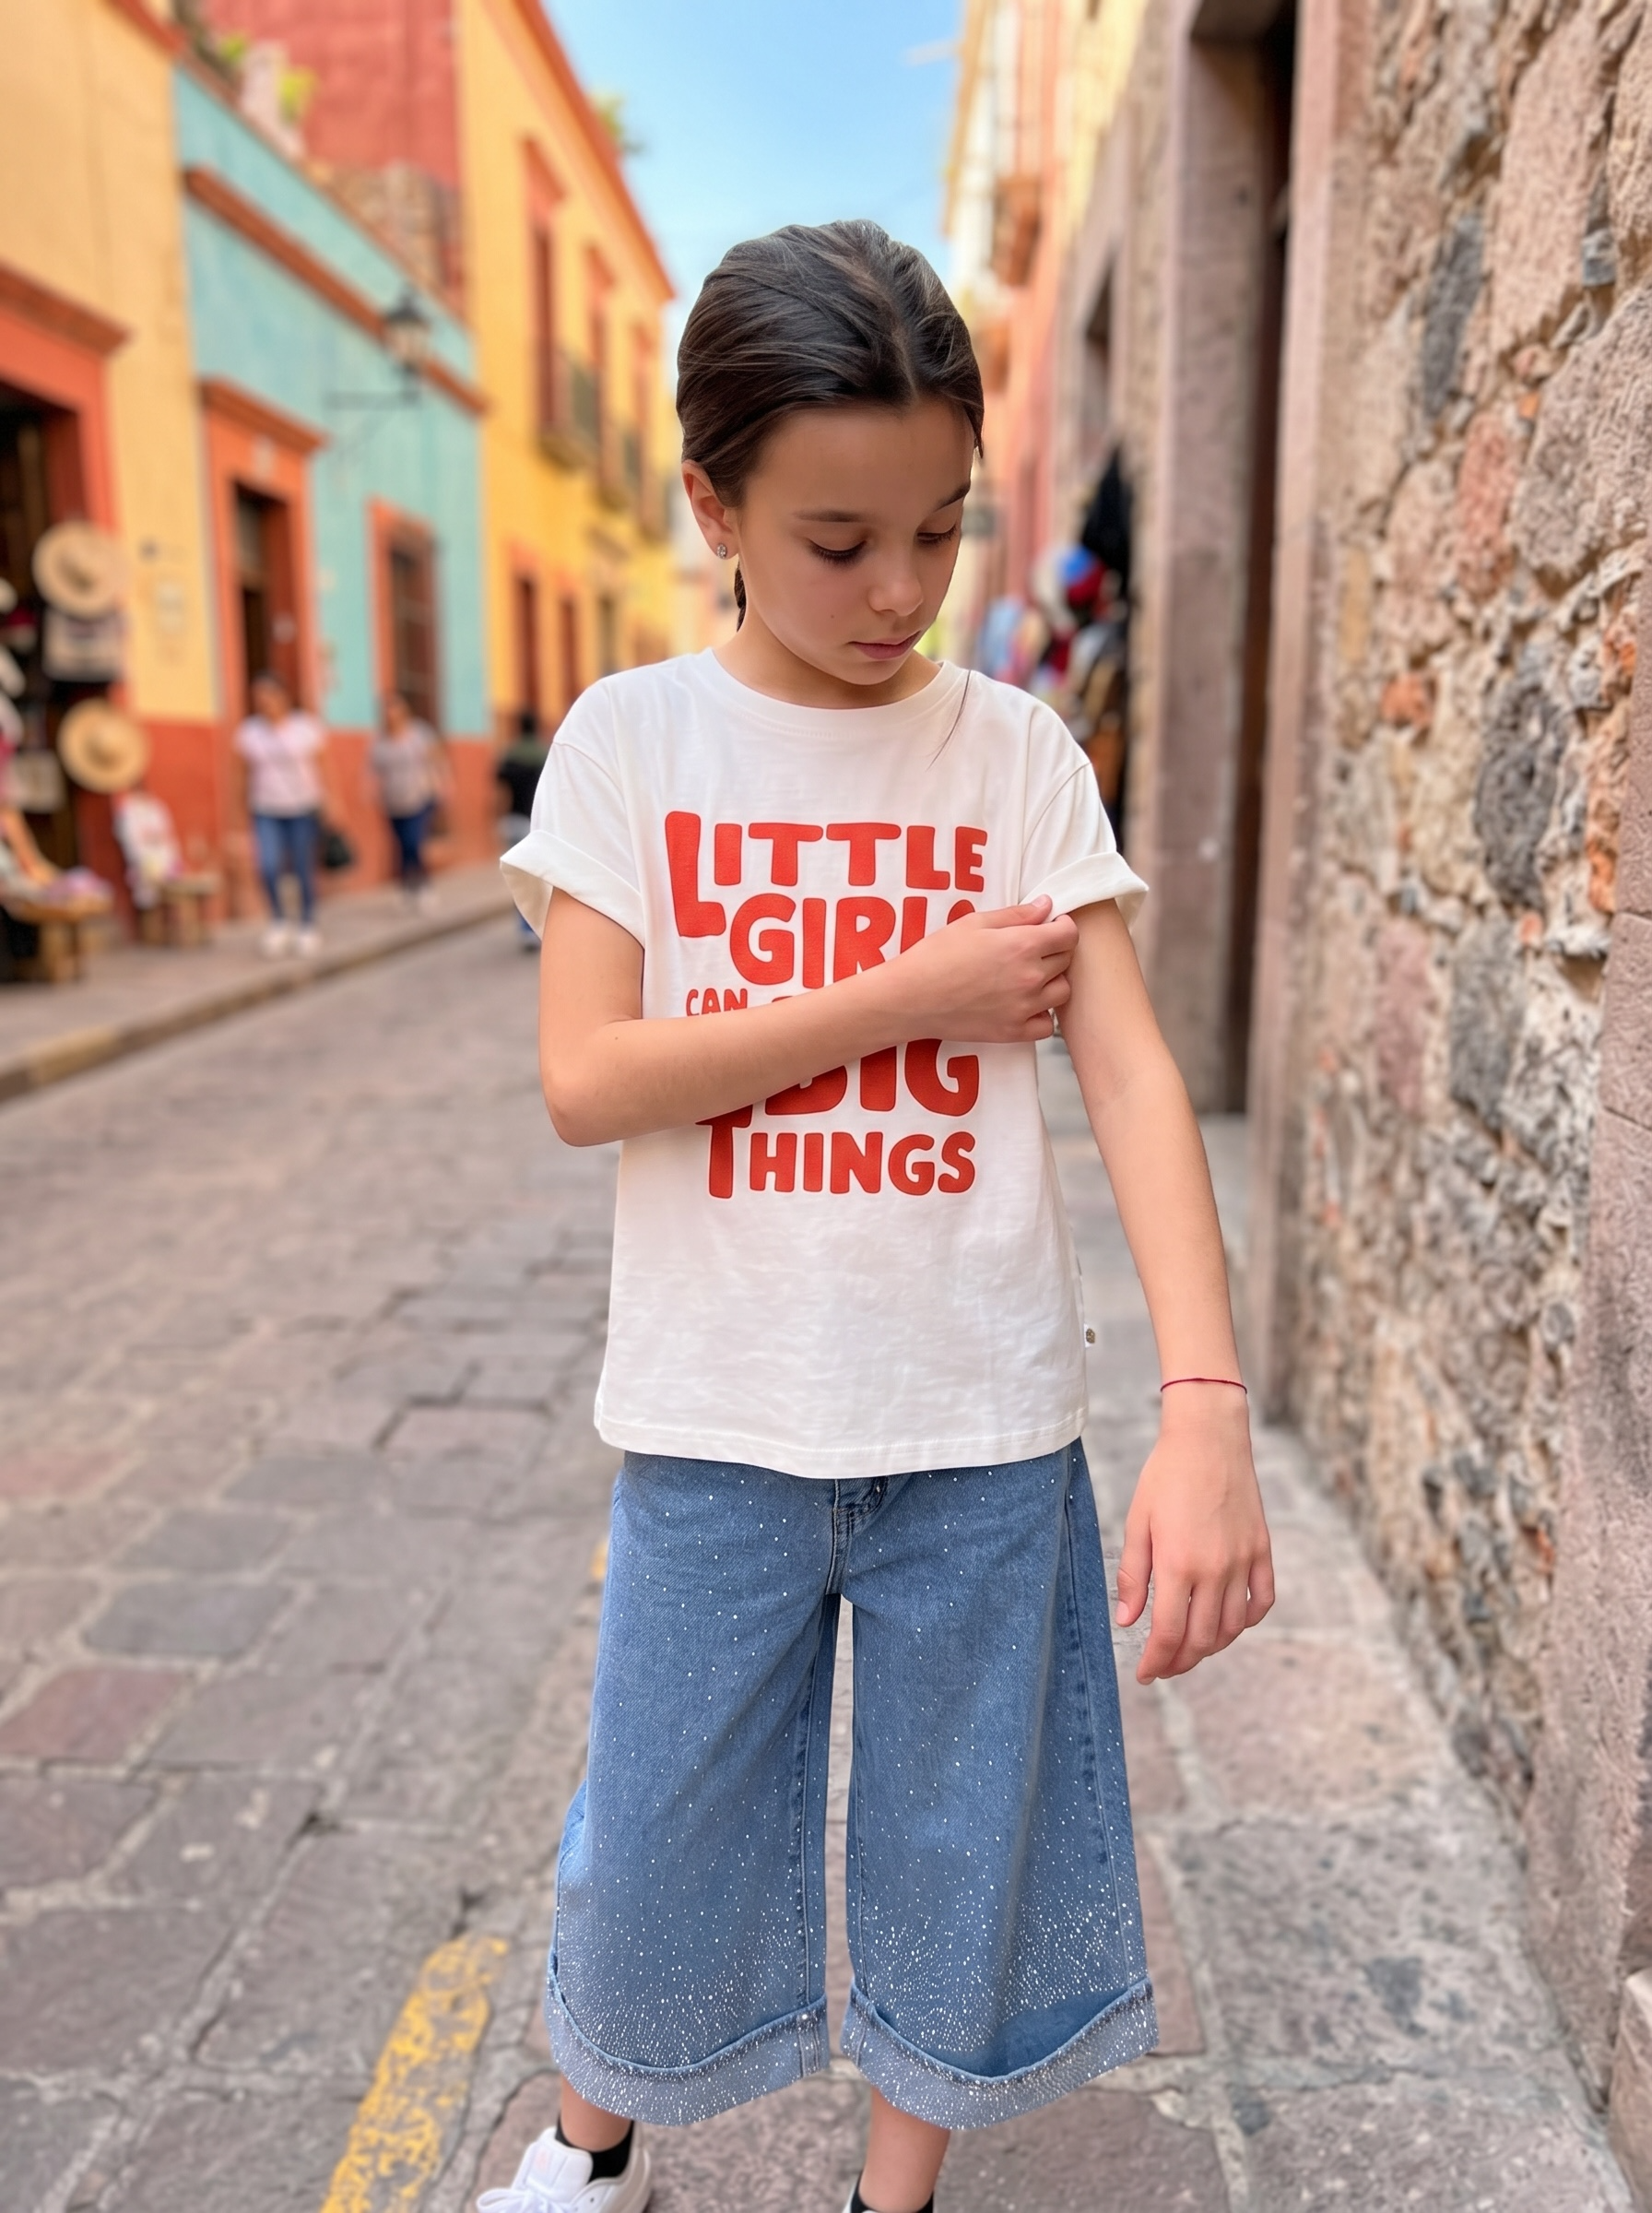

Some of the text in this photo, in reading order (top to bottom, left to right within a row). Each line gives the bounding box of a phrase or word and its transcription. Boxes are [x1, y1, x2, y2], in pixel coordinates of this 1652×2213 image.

[665, 811, 987, 939] LITTLE
[729, 893, 975, 989] GIR
[686, 988, 748, 1017] CAN
[695, 1105, 976, 1199] THINGS
